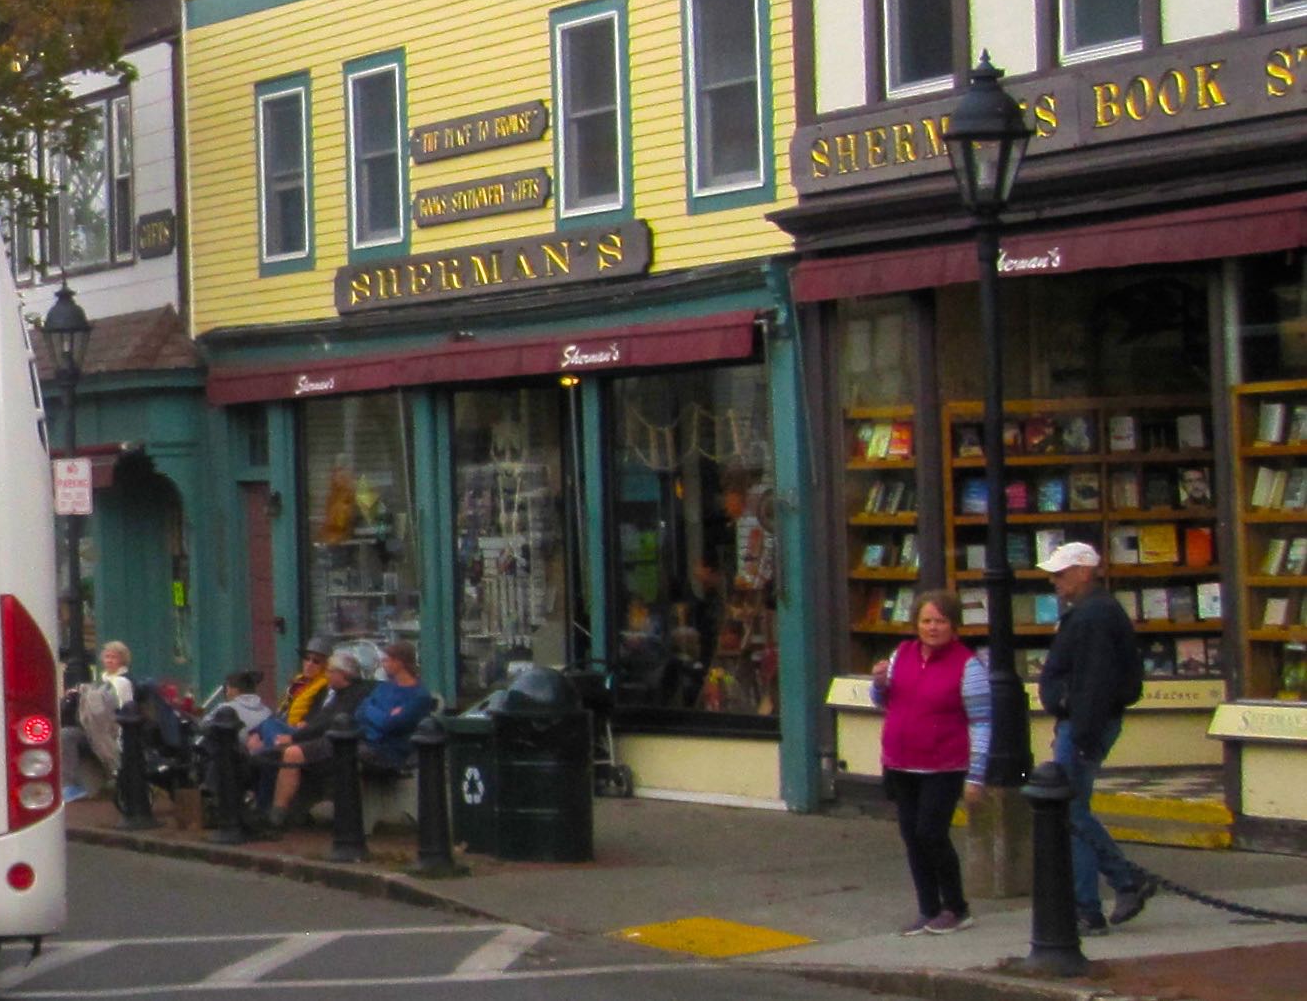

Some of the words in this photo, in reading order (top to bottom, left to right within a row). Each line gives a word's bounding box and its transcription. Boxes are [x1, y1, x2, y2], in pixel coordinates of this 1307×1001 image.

[810, 91, 1058, 179] SHERM'S
[1092, 61, 1229, 128] BOOK
[350, 233, 624, 306] SHERMAN'S
[996, 246, 1061, 272] herman's
[561, 342, 620, 368] Sherman's
